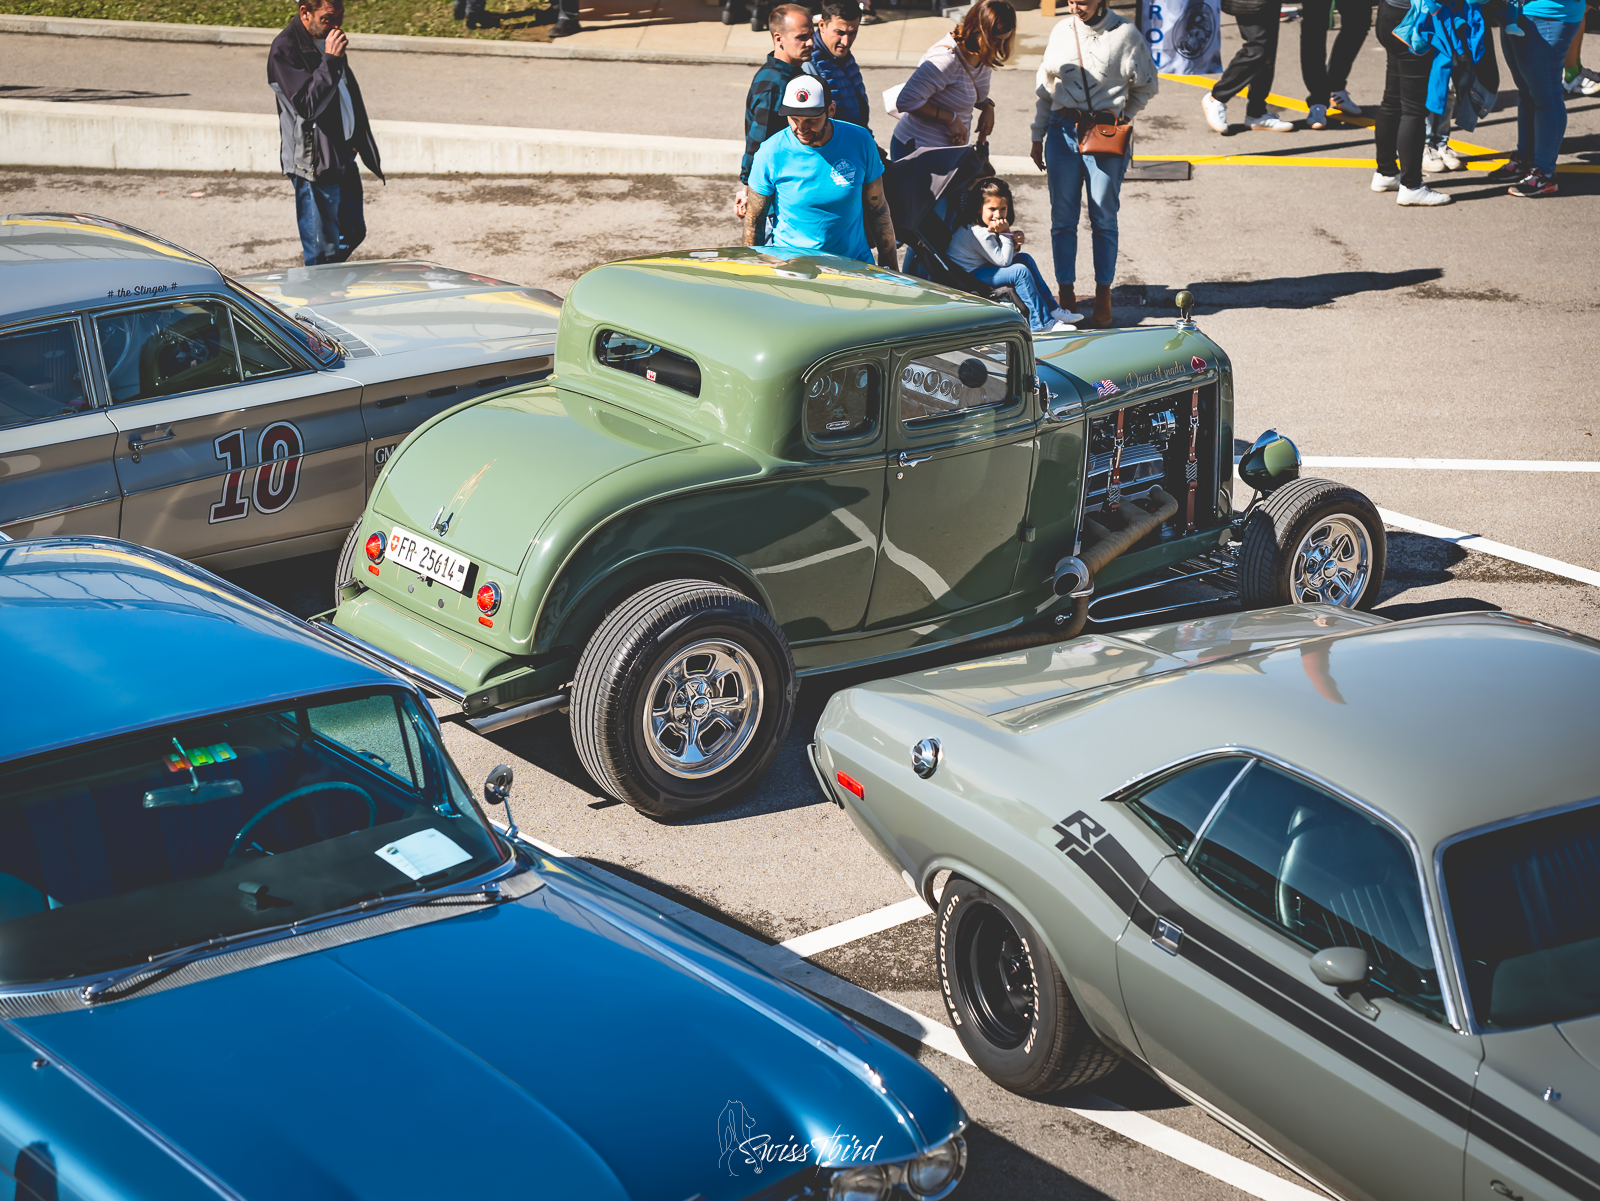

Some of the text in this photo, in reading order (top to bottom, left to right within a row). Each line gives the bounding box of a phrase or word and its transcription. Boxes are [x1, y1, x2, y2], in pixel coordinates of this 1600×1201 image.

[117, 287, 132, 298] the
[133, 284, 168, 297] Slinger
[208, 419, 305, 525] 10
[418, 546, 457, 581] 25614
[939, 894, 963, 1026] BFGoodrich
